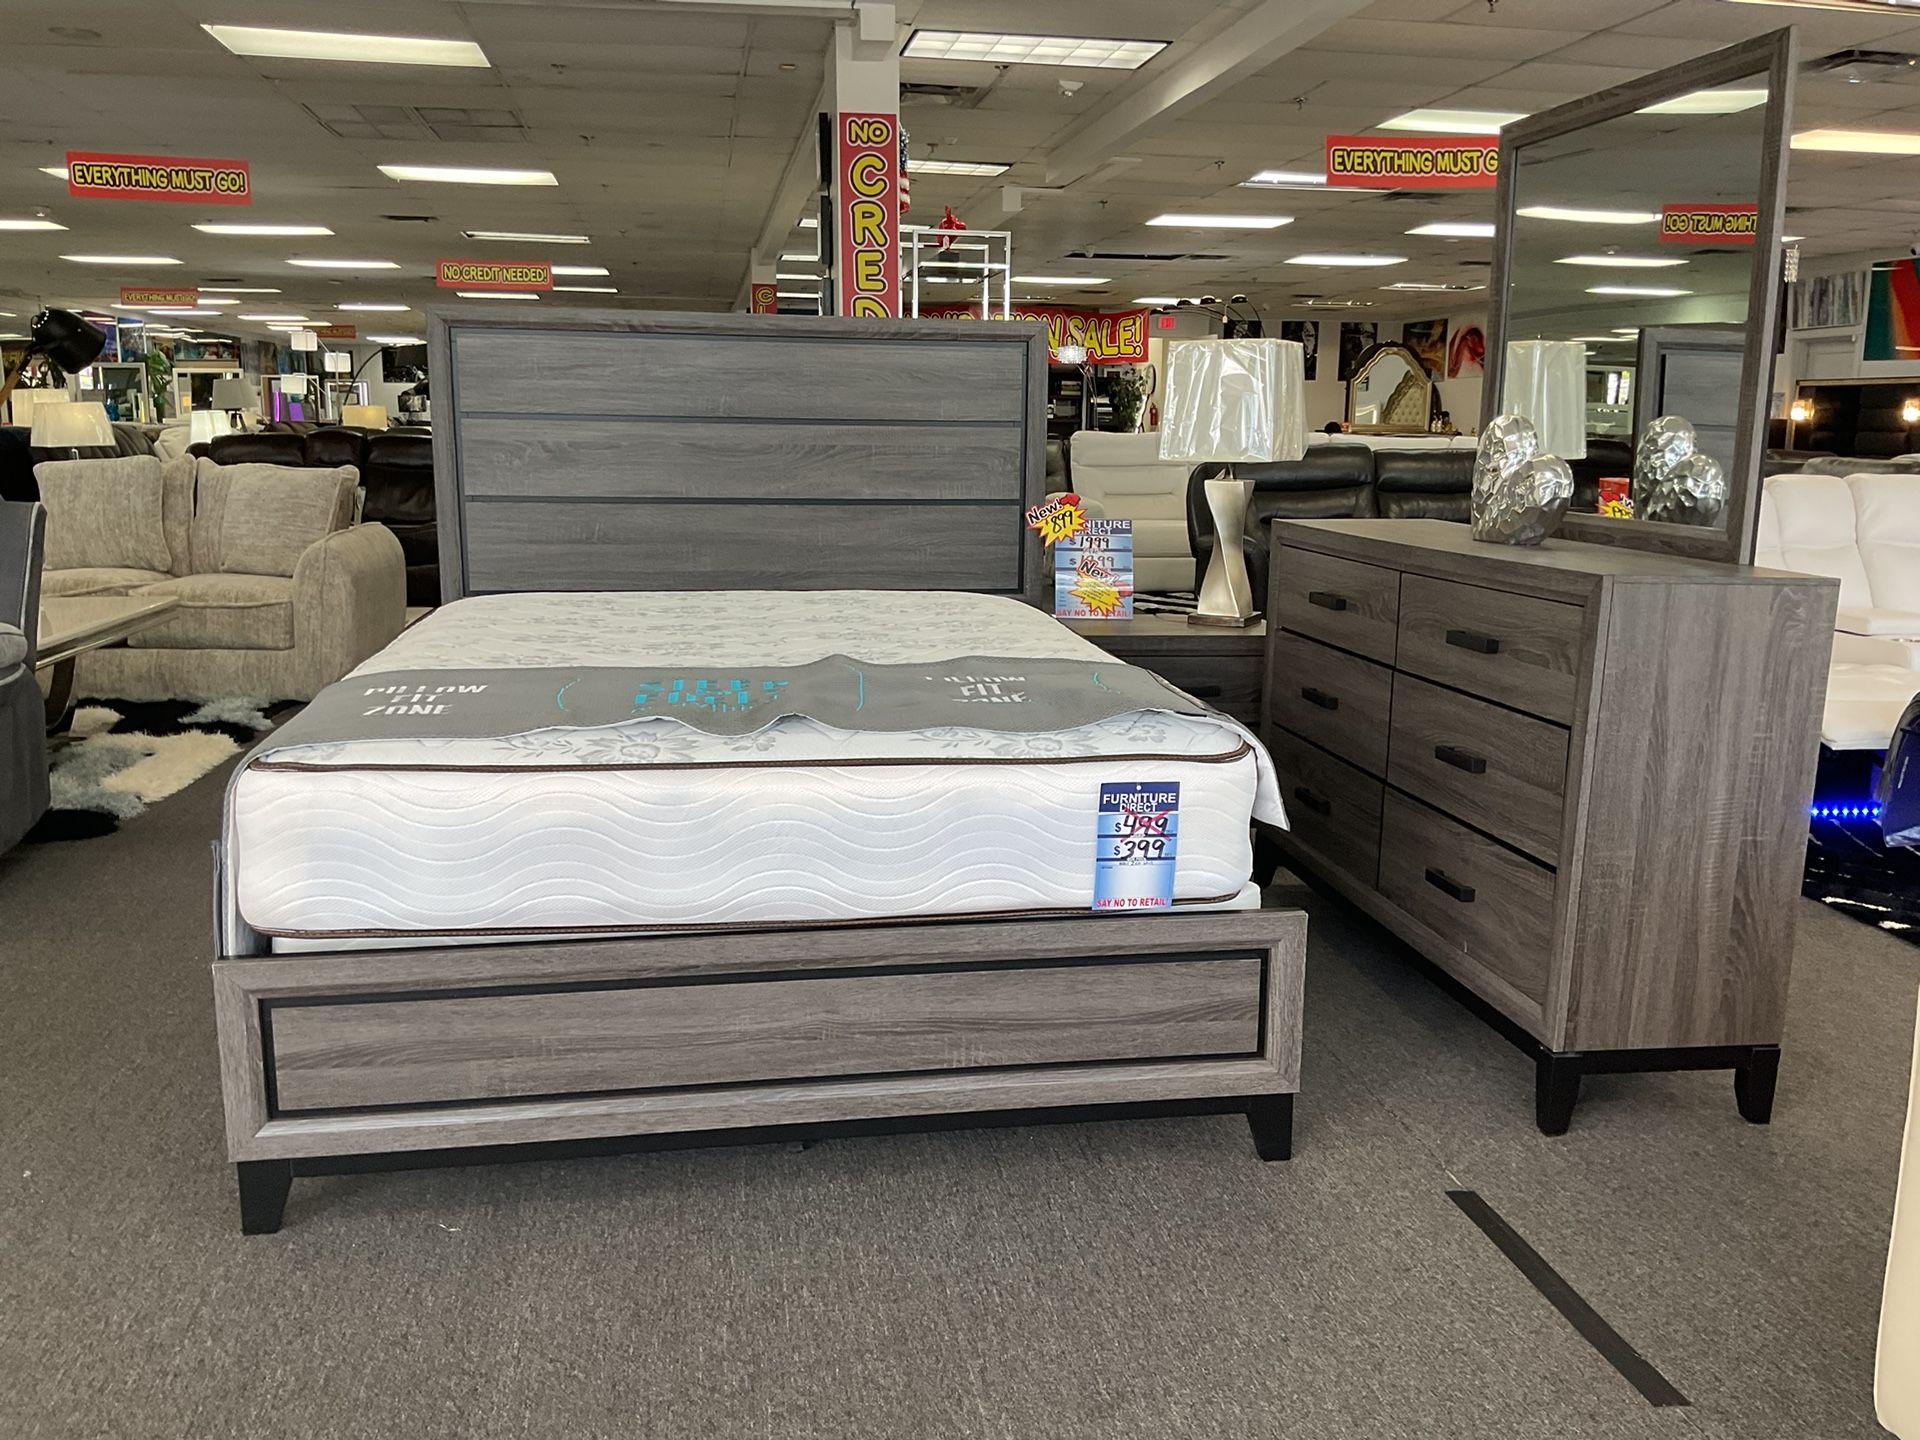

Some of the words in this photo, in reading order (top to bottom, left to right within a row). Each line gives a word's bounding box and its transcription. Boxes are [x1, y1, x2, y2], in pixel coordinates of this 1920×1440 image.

[850, 120, 889, 144] NO
[1333, 149, 1432, 174] EVERYTHING
[1435, 150, 1482, 174] MUST
[73, 163, 168, 189] EVERYTHING
[170, 169, 213, 191] MUST
[215, 171, 246, 193] GO!
[443, 264, 461, 280] NO
[462, 265, 501, 281] CREDIT
[502, 267, 548, 282] NEEDED!
[1066, 315, 1143, 357] SALE!
[1028, 498, 1062, 525] New!
[1051, 510, 1073, 533] 899
[1085, 520, 1131, 529] NITURE
[1075, 609, 1086, 617] NO
[960, 683, 1001, 696] FIT
[1103, 793, 1176, 804] FURNITURE
[1120, 803, 1158, 812] DIRECT
[1096, 899, 1111, 907] SAY
[1114, 898, 1125, 907] NO
[1128, 898, 1138, 906] TO
